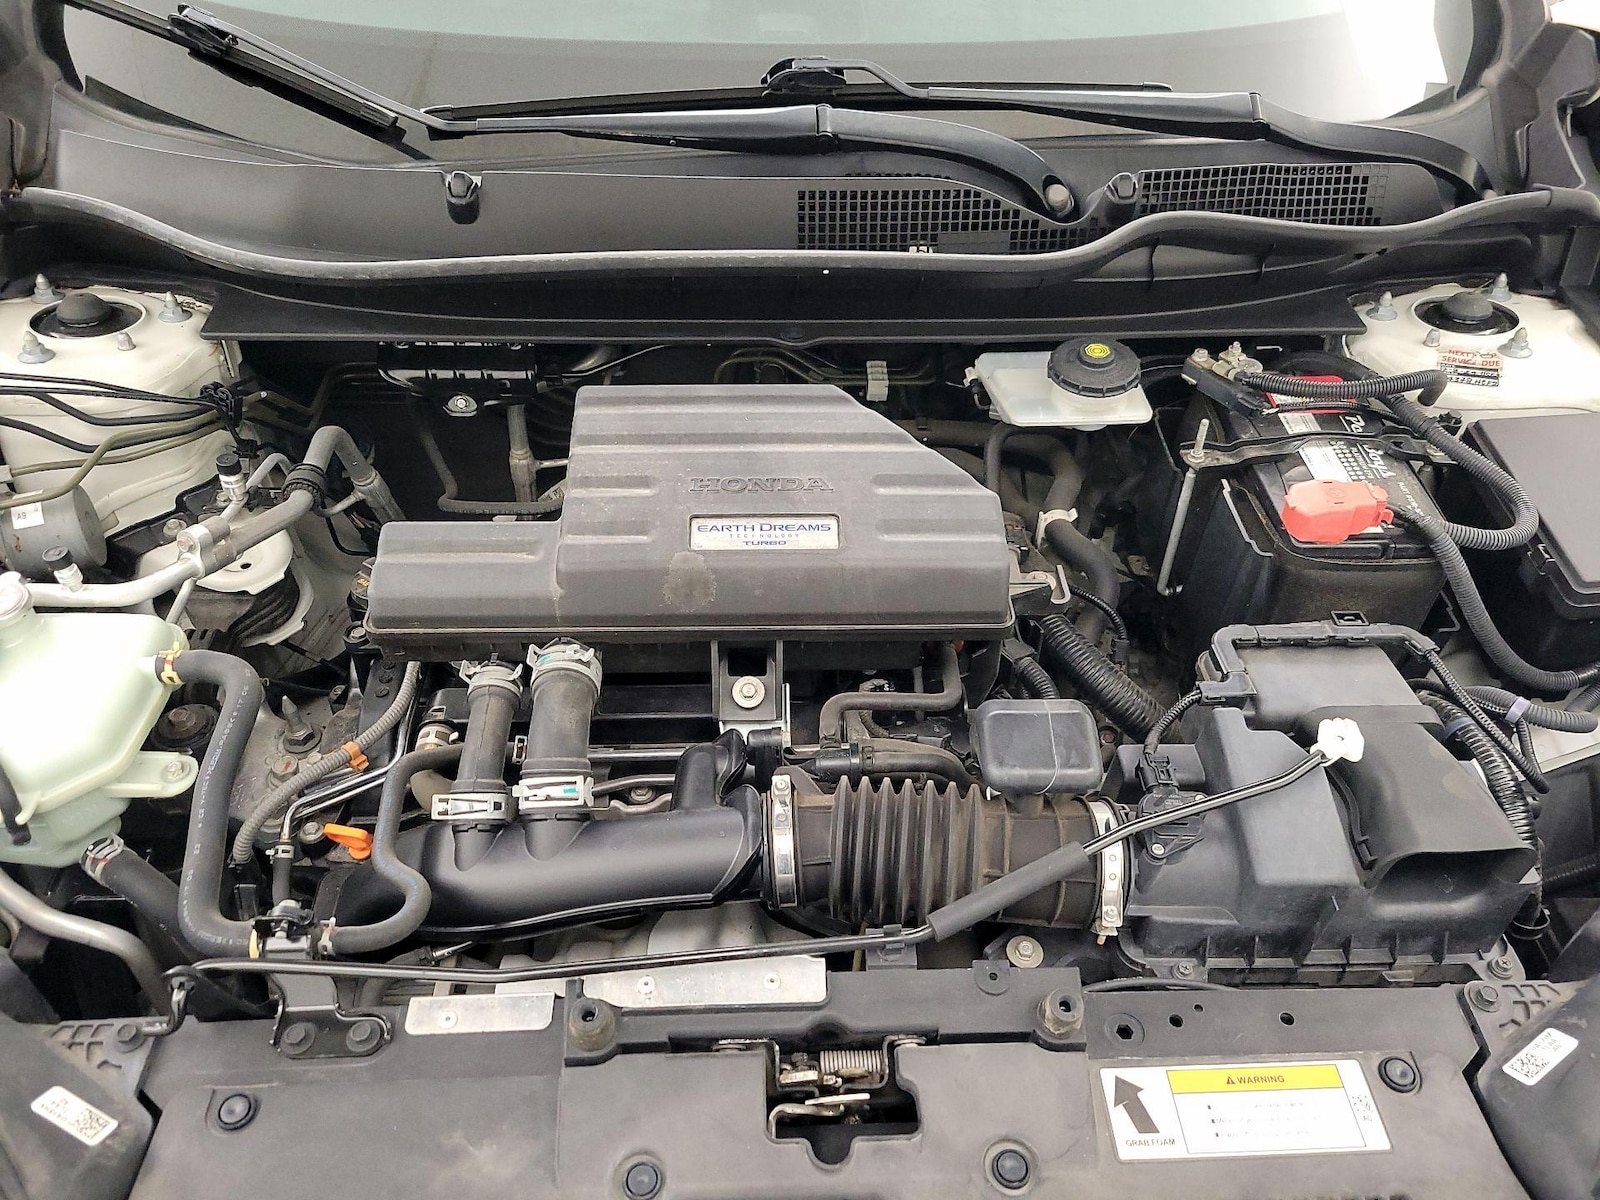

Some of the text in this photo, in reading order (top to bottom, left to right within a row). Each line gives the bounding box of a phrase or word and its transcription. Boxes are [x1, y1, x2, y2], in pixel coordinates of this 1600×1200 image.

[1448, 349, 1471, 357] NEXT
[690, 477, 834, 493] HONDA
[697, 523, 831, 532] EARTH DREAMS
[1237, 1074, 1285, 1084] WARNING
